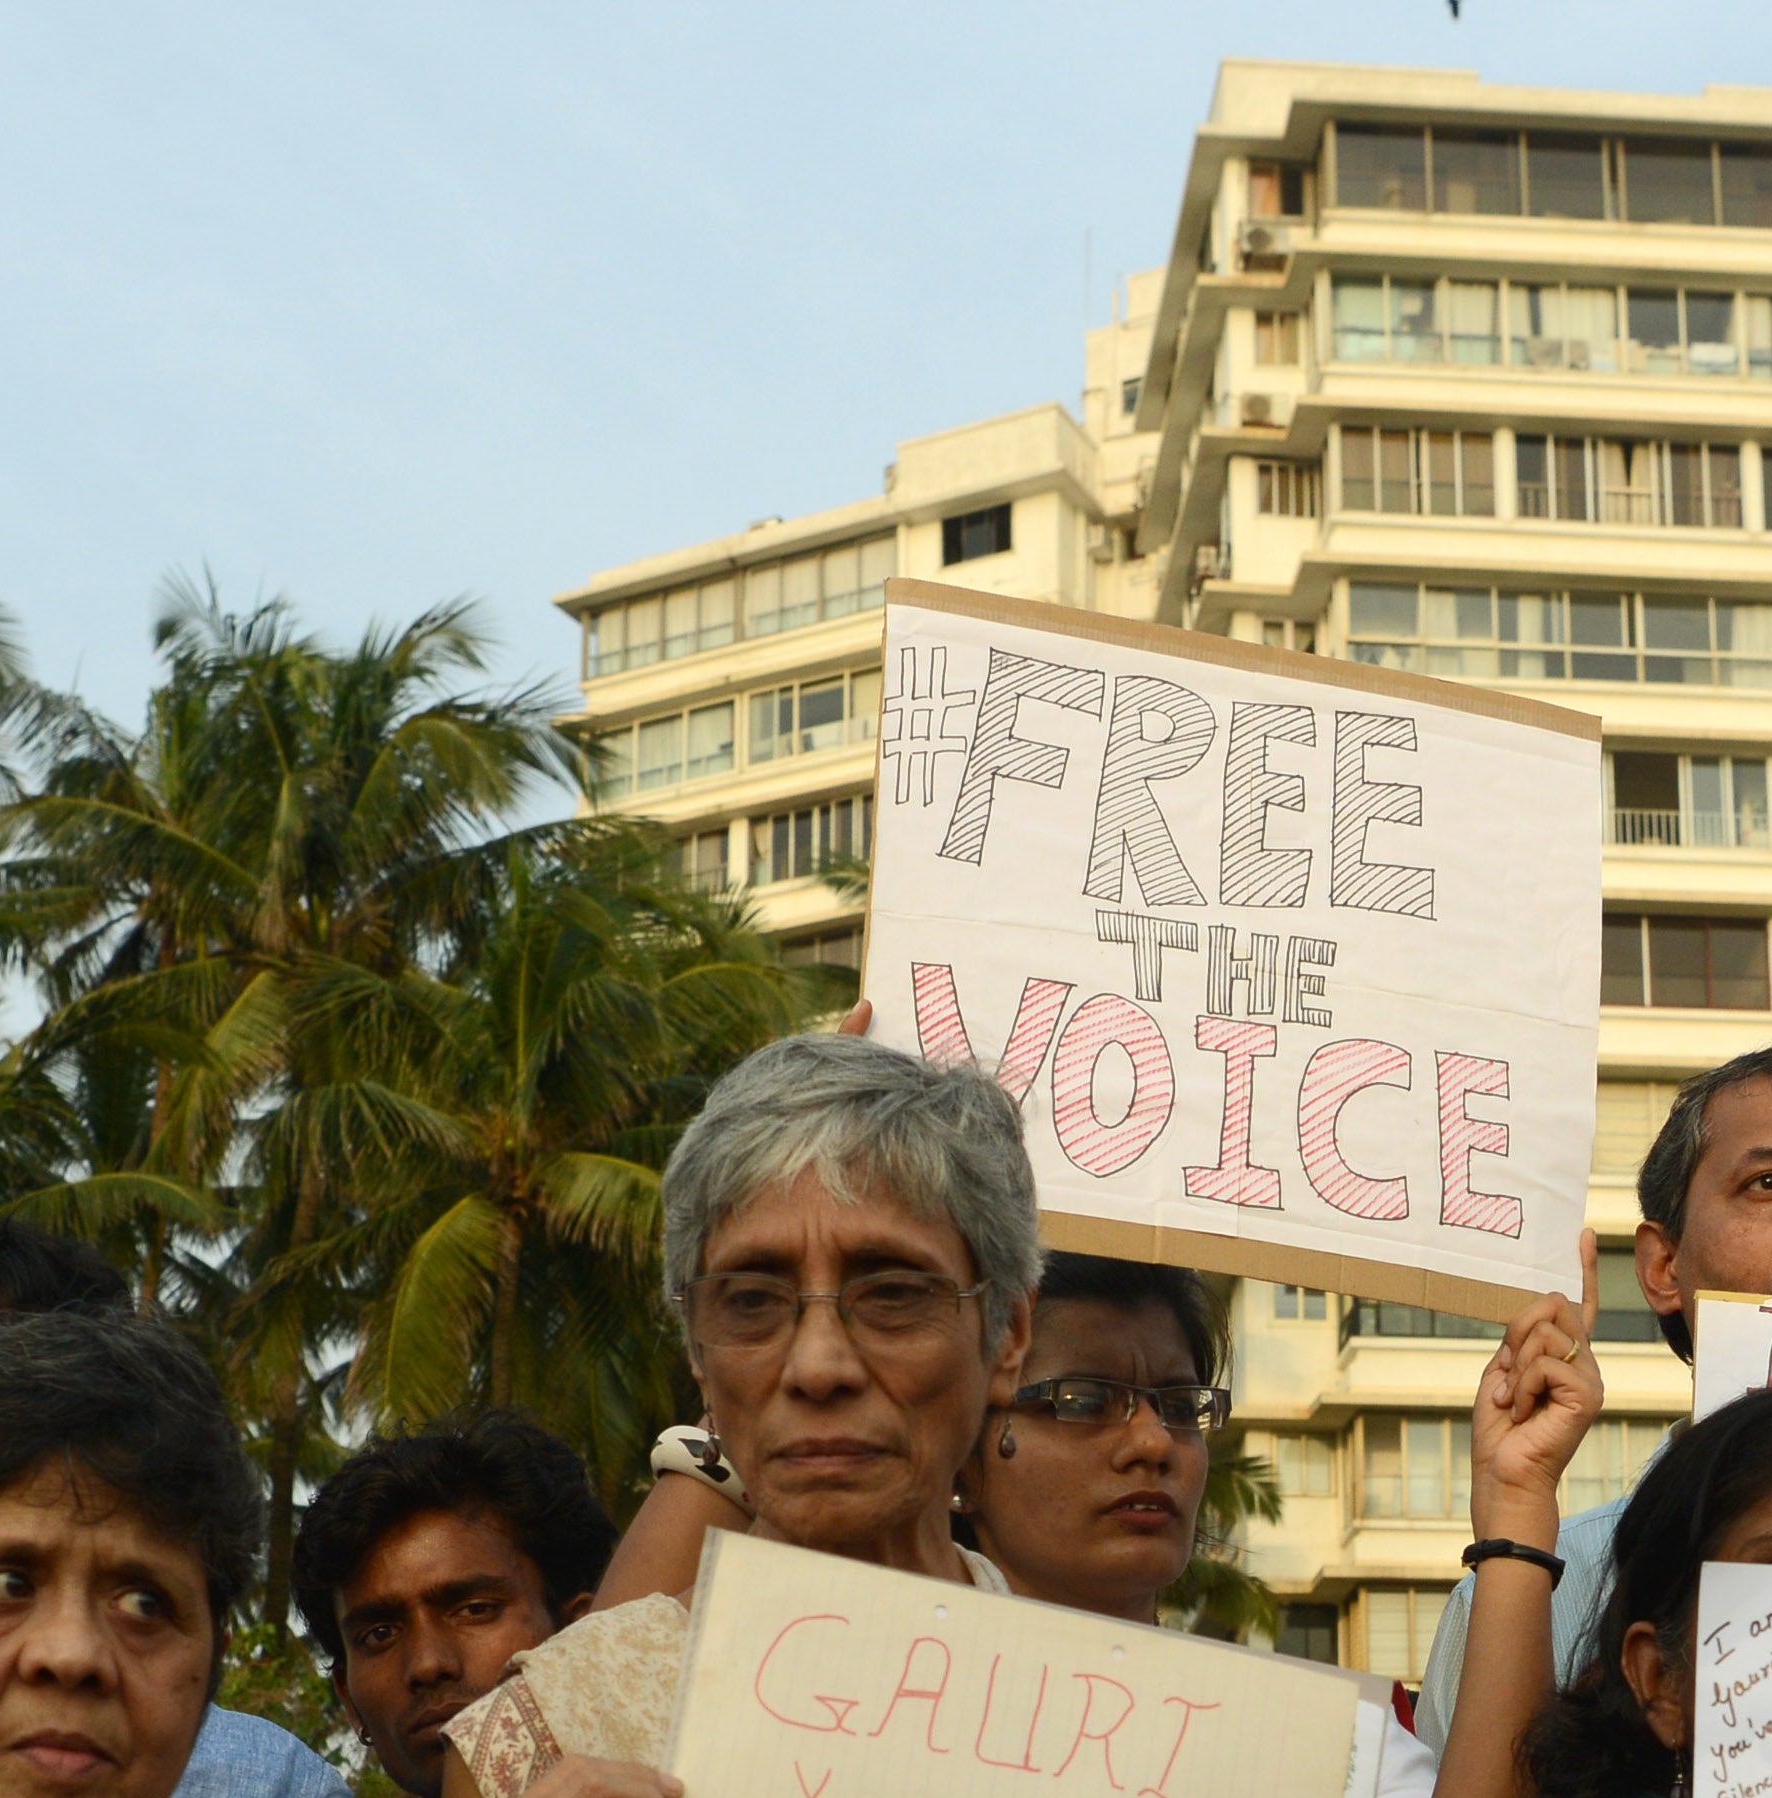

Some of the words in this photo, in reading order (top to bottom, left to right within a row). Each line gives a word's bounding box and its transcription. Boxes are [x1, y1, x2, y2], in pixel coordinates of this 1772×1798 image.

[884, 647, 1435, 920] #FREE
[1096, 910, 1336, 1027] THE
[911, 963, 1522, 1239] VOICE
[1704, 1621, 1735, 1665] I
